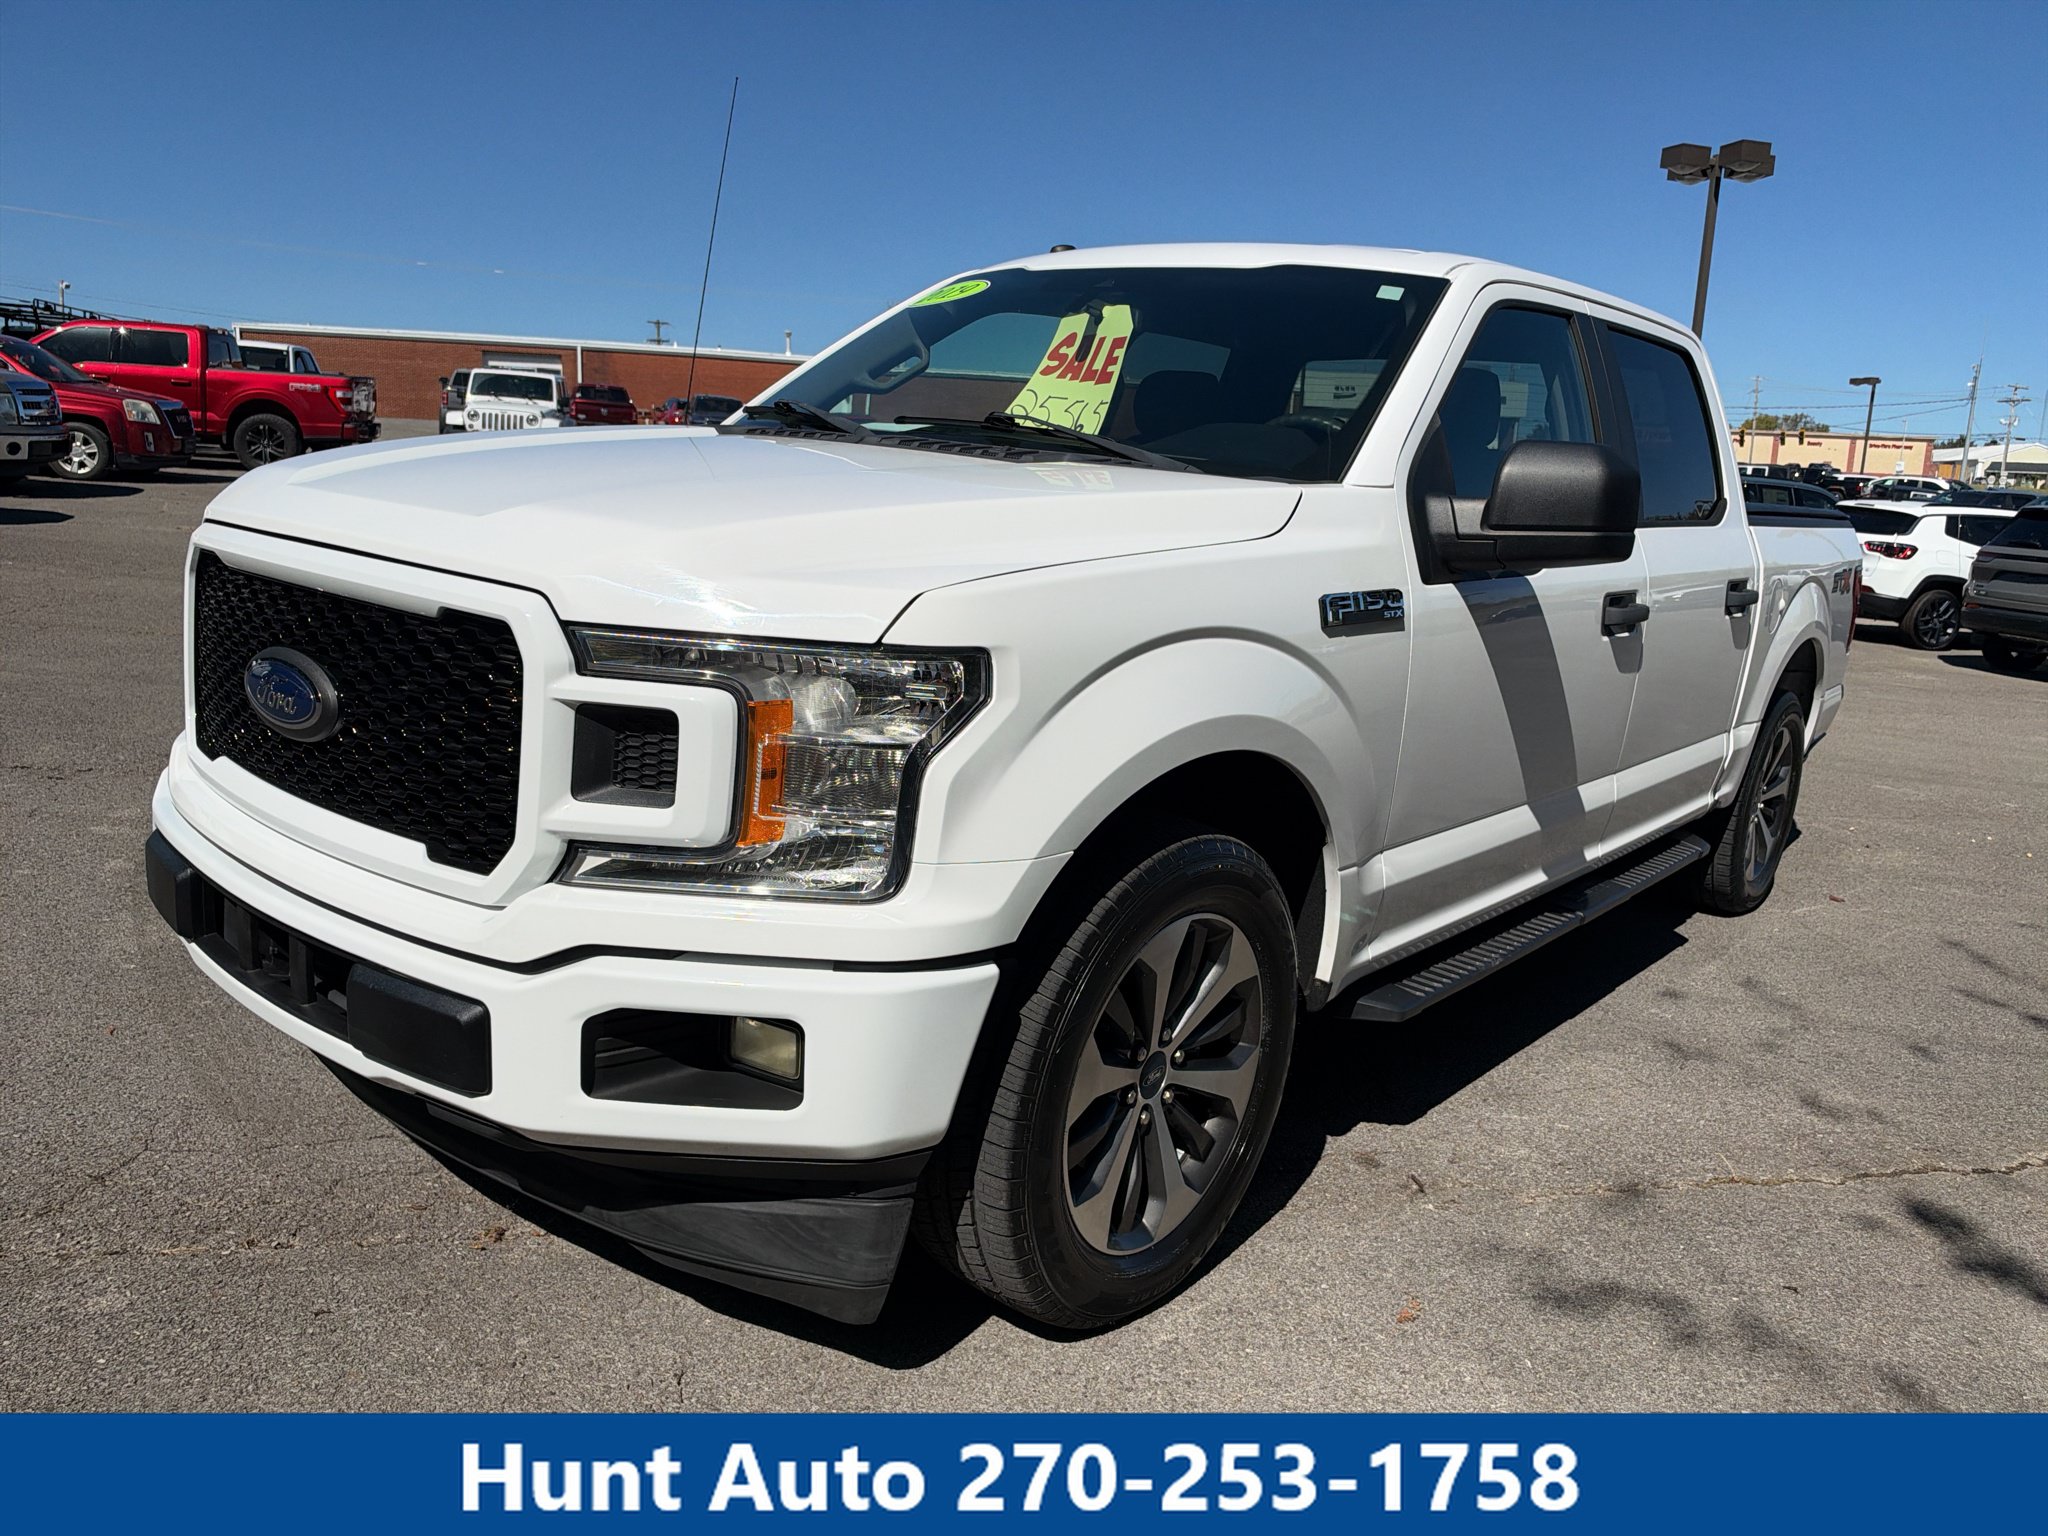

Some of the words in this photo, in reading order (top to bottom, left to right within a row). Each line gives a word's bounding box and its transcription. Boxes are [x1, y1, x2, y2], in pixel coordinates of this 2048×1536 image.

[1039, 331, 1128, 386] SALE
[1383, 609, 1404, 619] STX
[256, 674, 298, 715] Ford
